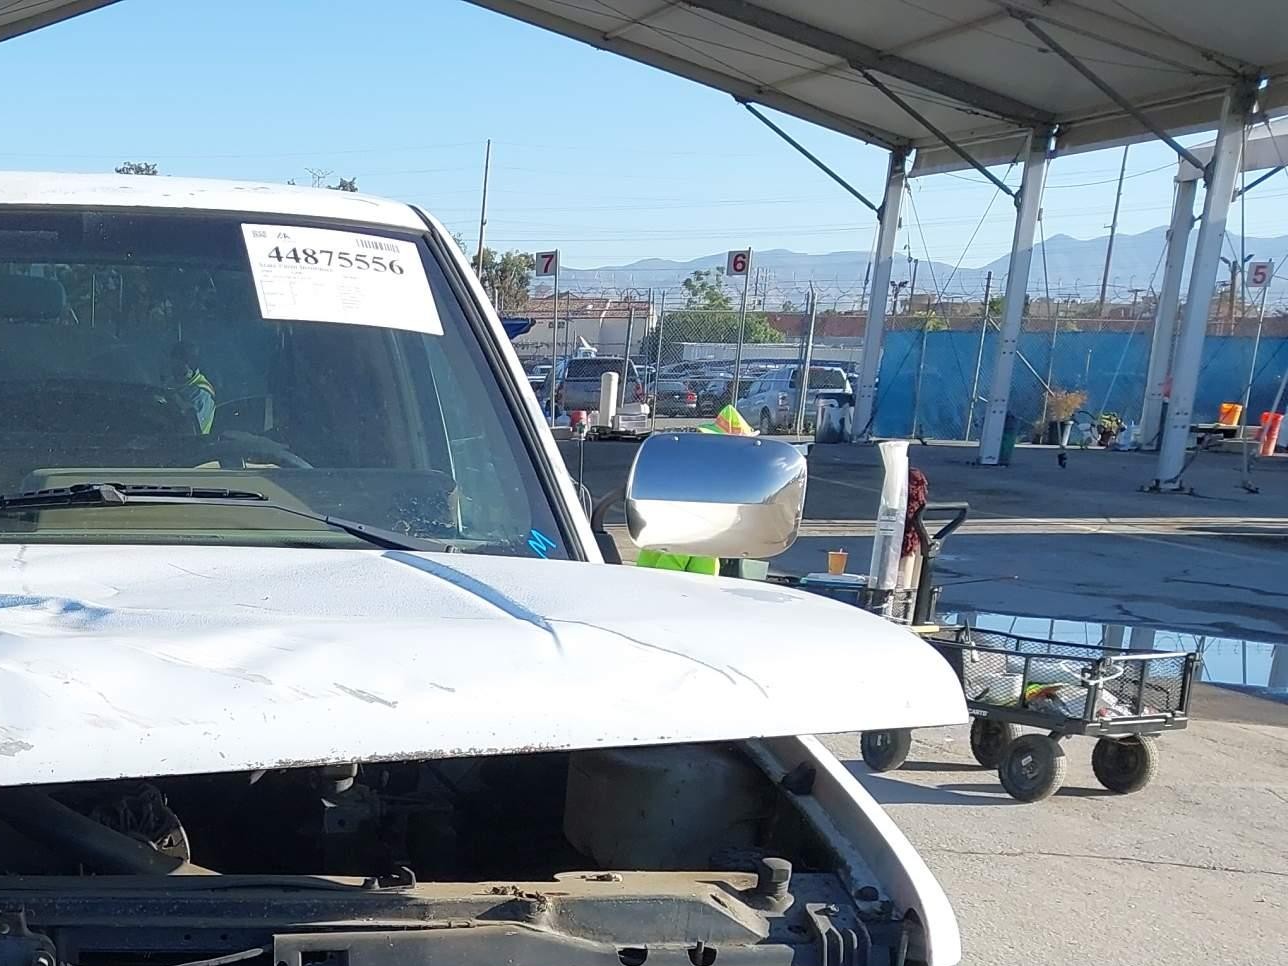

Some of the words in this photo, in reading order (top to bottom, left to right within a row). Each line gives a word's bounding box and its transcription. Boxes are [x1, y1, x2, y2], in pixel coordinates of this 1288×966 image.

[268, 246, 405, 275] 44875556
[541, 254, 554, 273] 7
[733, 253, 746, 272] 6
[1252, 265, 1268, 284] 5
